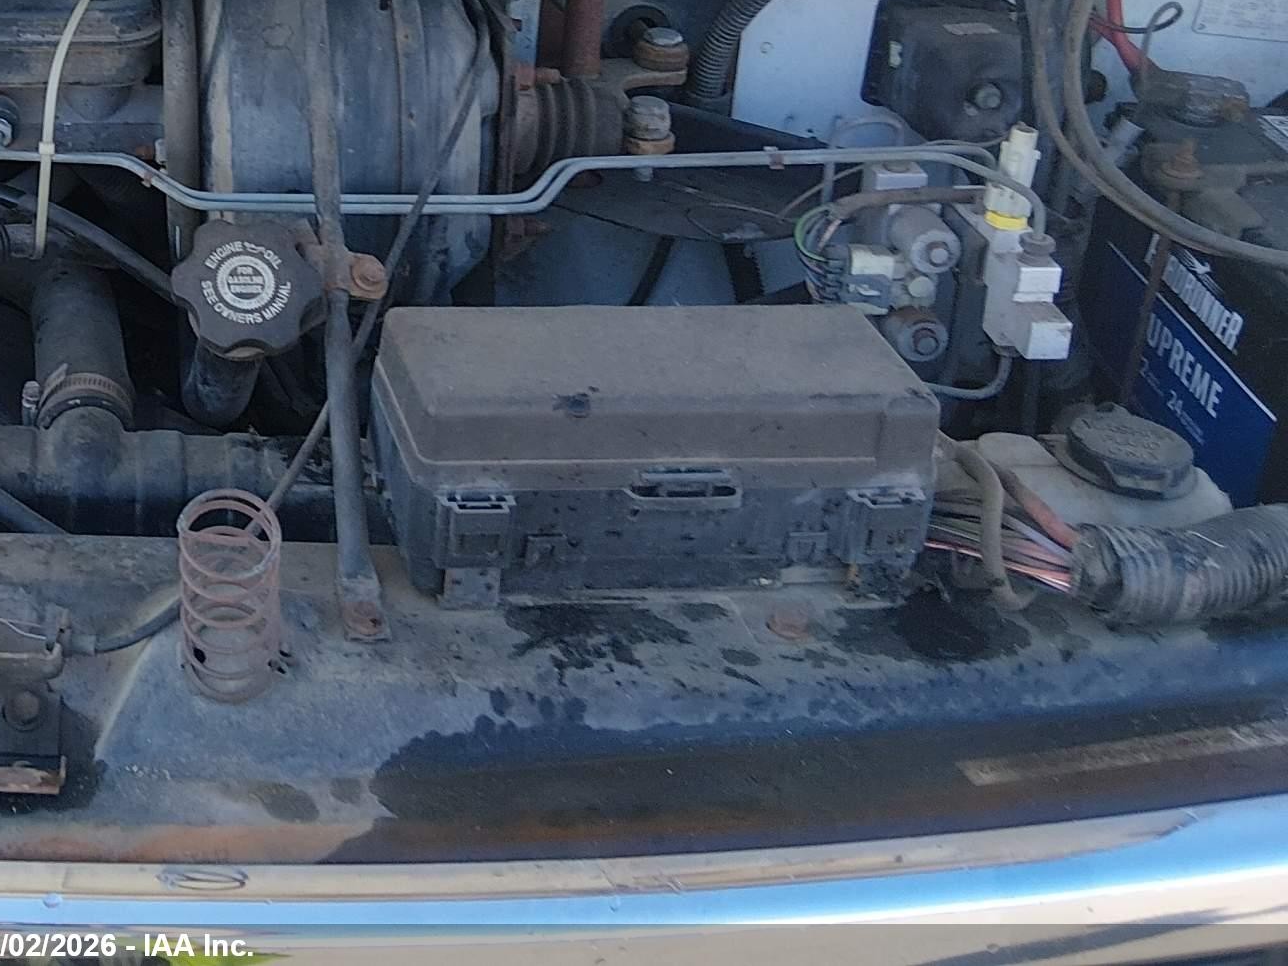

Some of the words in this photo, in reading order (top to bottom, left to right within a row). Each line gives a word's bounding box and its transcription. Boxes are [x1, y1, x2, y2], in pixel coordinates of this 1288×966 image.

[204, 241, 244, 270] ENGINE
[263, 249, 283, 271] OIL
[201, 280, 219, 306] SEE
[213, 302, 263, 325] OWNERS
[261, 281, 292, 321] MANUAL
[1146, 312, 1224, 419] UPREME
